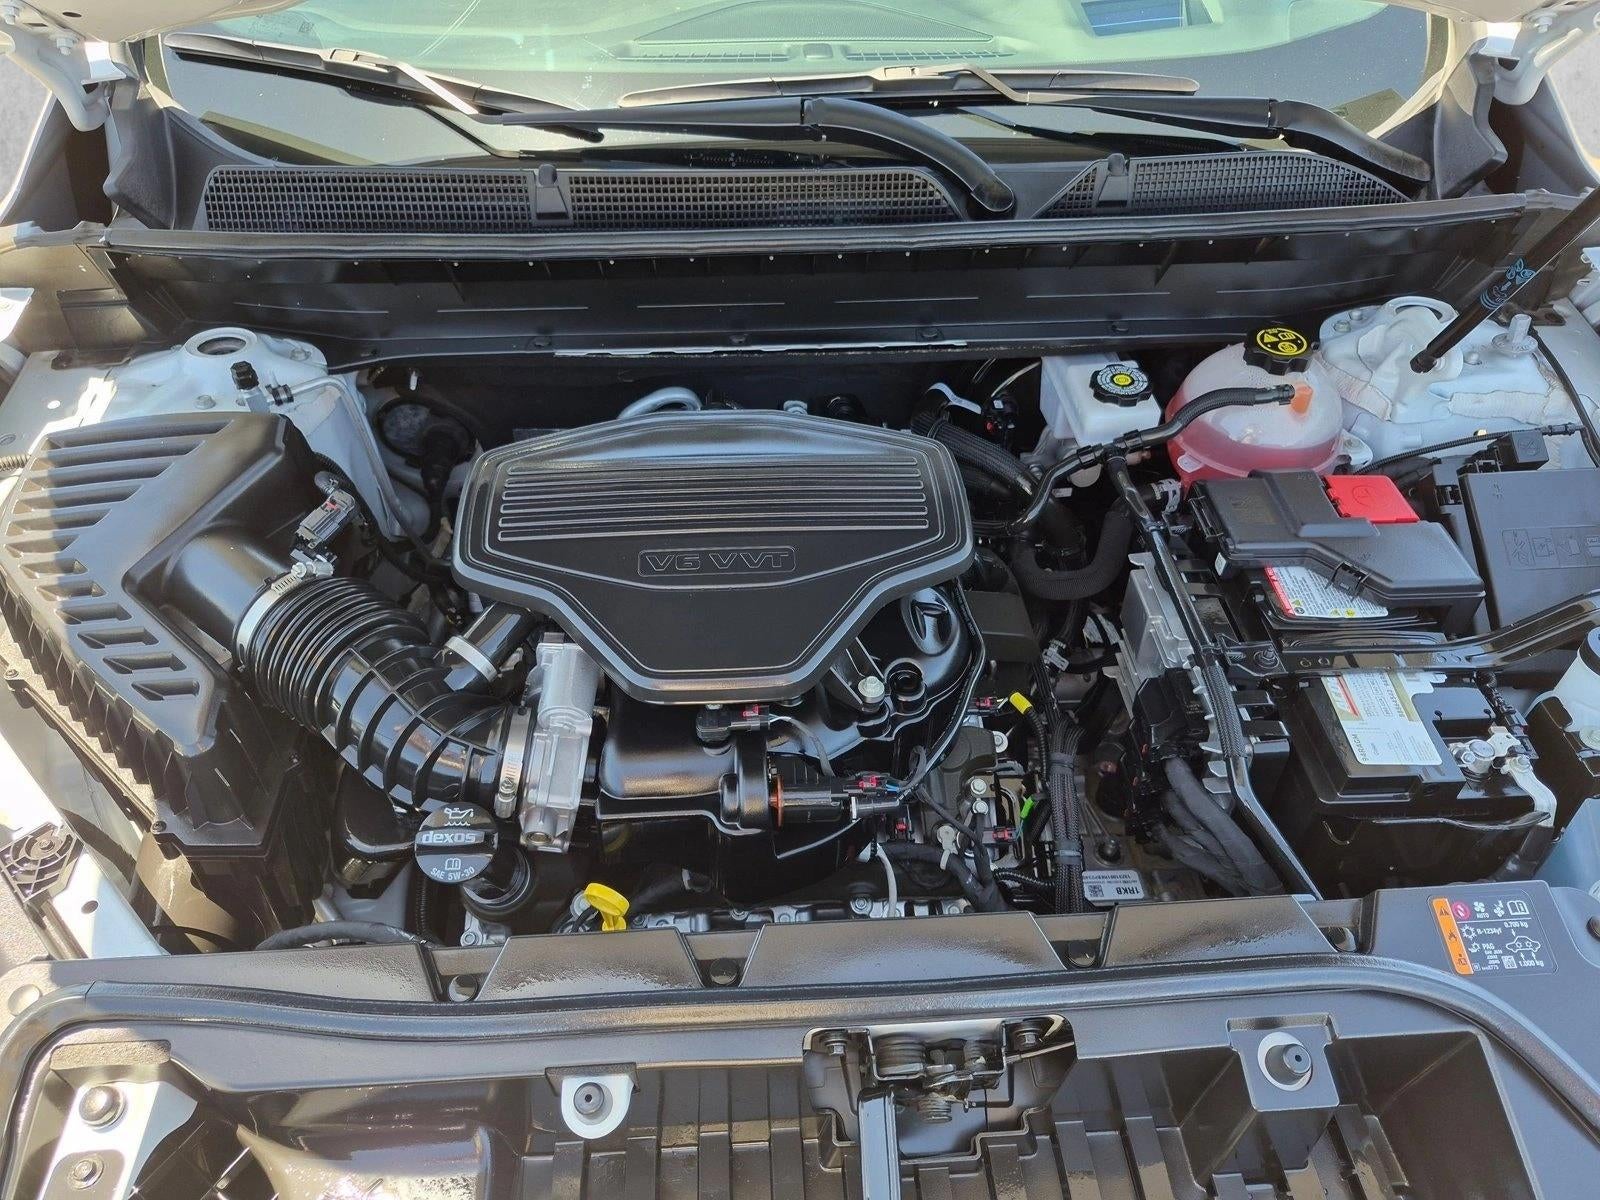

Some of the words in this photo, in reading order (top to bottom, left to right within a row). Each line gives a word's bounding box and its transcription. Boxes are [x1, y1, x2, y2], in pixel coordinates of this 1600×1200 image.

[645, 553, 701, 571] V6
[708, 551, 789, 570] VVT
[421, 831, 476, 844] dexos
[430, 867, 445, 880] SAE
[447, 866, 475, 881] 5W-30
[1115, 886, 1141, 896] 1RKB
[1520, 921, 1529, 929] kg
